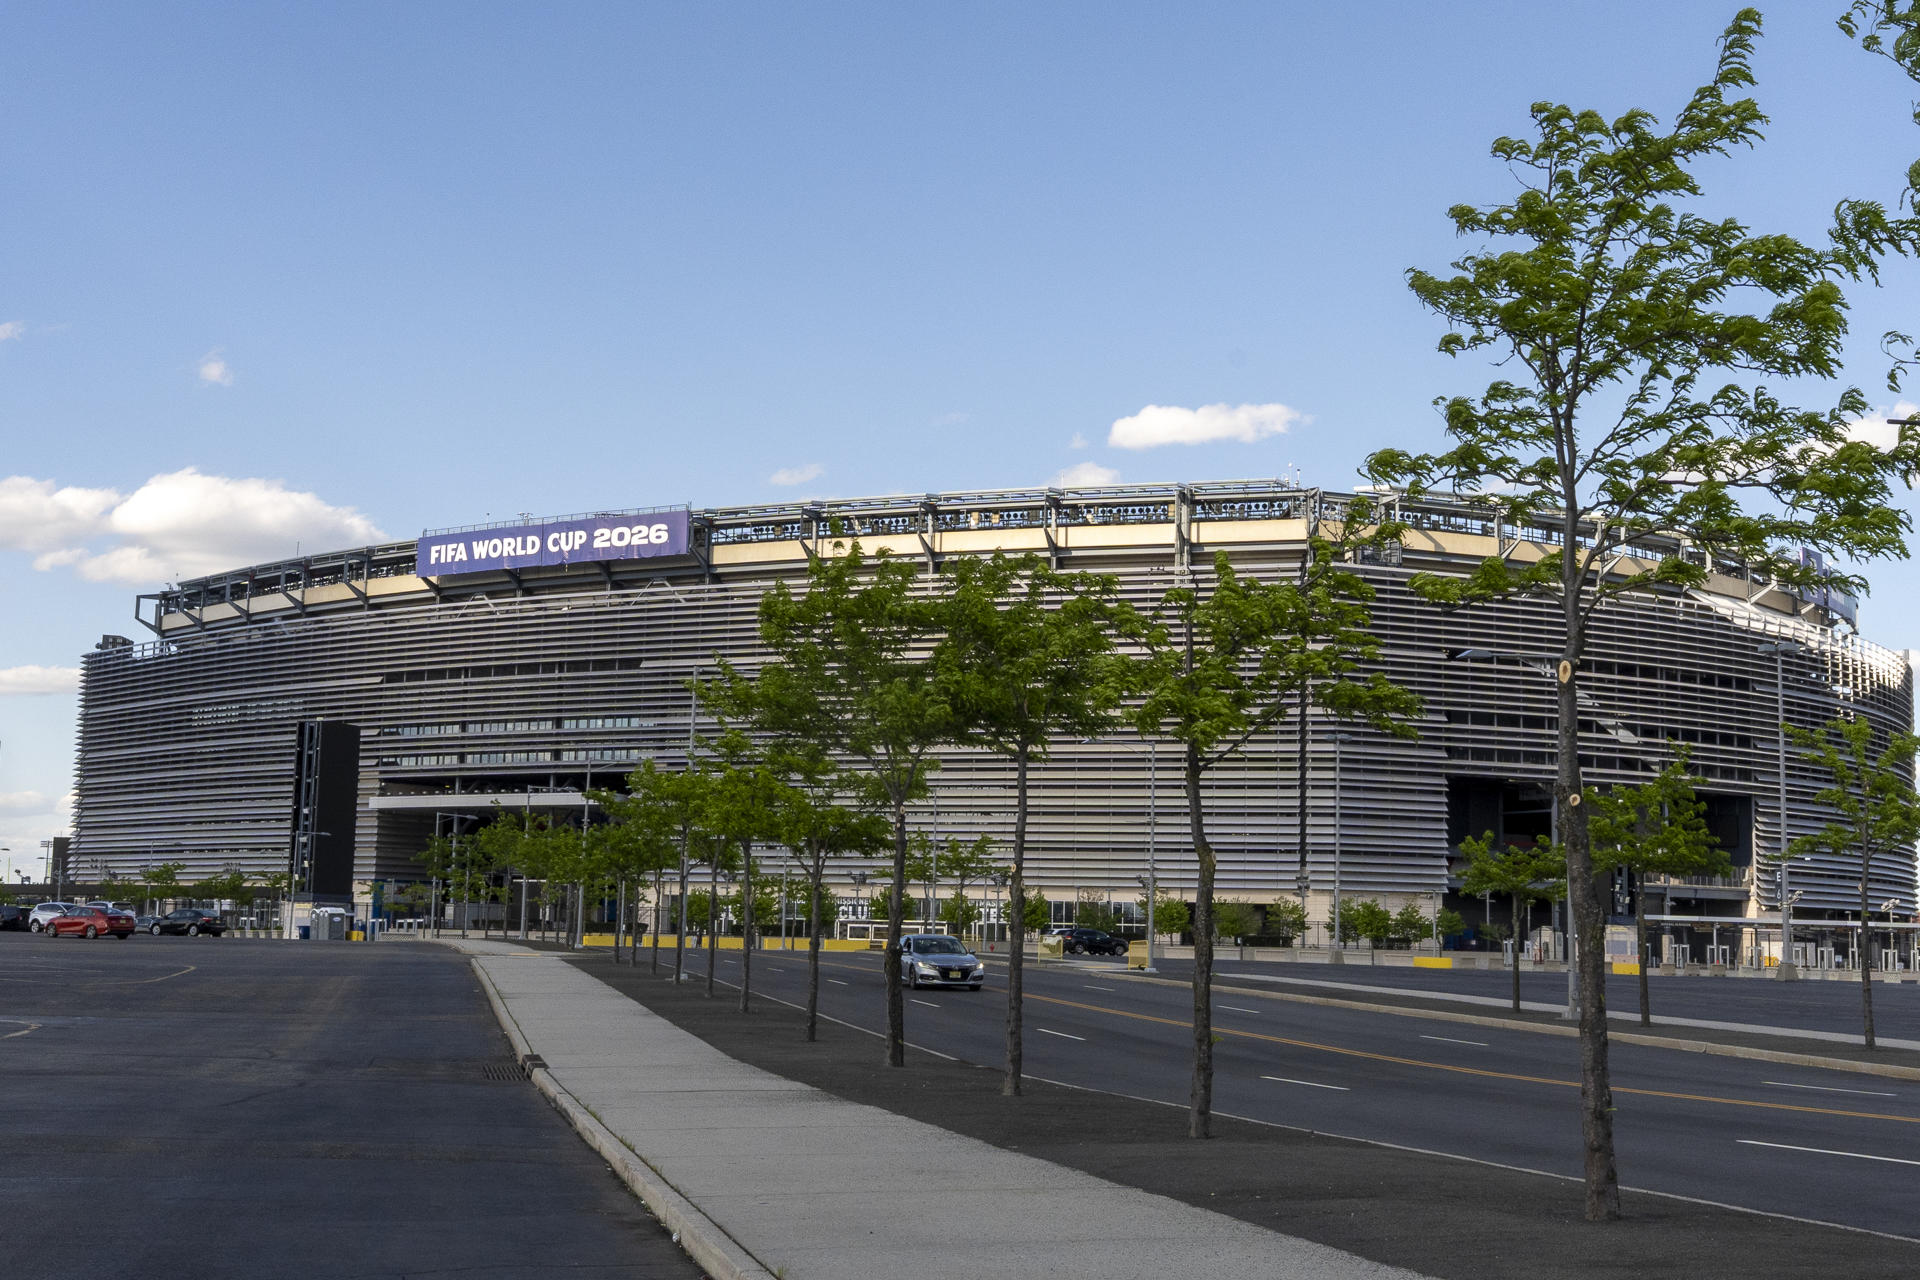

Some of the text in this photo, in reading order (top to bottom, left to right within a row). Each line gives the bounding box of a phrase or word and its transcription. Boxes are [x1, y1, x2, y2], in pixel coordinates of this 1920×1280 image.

[430, 524, 669, 565] FIFA WORLD CUP 2026
[1776, 871, 1782, 882] E
